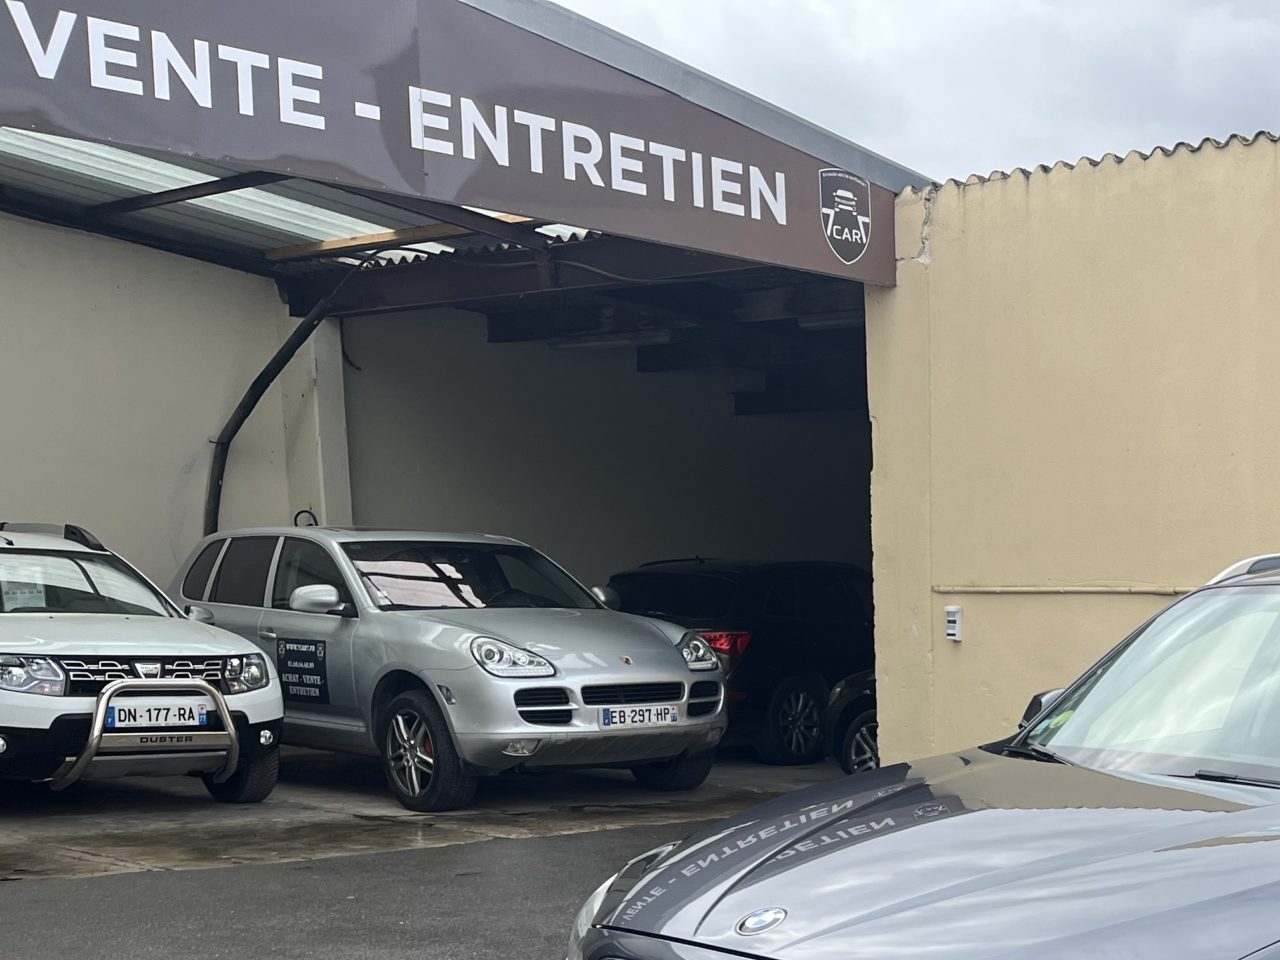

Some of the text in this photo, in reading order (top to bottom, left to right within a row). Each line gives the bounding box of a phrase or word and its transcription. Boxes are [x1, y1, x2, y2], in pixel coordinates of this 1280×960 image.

[5, 0, 326, 130] VENTE
[409, 86, 787, 226] ENTRETIEN
[303, 675, 321, 684] VENTE
[118, 707, 195, 722] DN-177-RA
[610, 708, 670, 724] EB-297-HP
